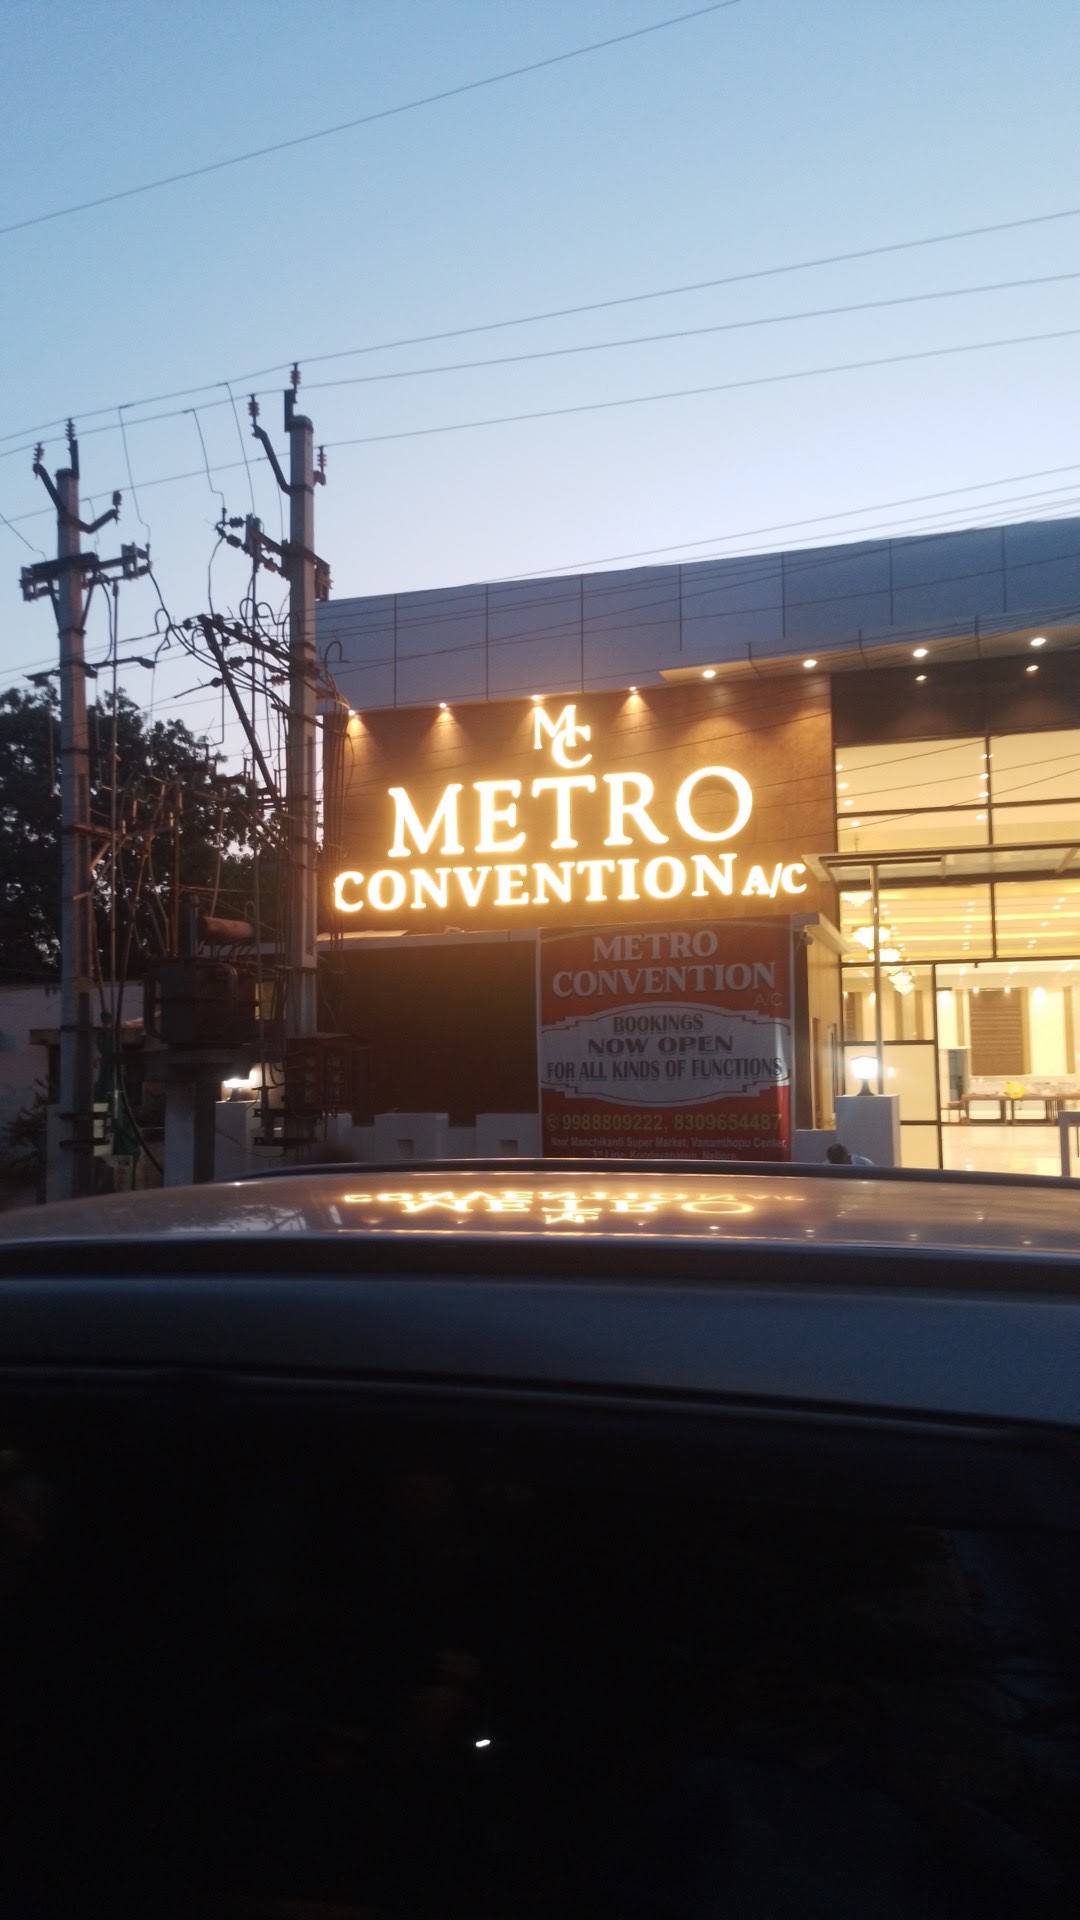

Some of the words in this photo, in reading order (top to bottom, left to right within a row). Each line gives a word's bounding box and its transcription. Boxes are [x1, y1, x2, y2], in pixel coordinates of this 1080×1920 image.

[387, 765, 753, 858] METRO
[333, 852, 738, 913] CONVENTION
[741, 862, 807, 898] A/C
[592, 930, 718, 963] METRO
[552, 961, 776, 998] CONVENTION
[613, 1013, 704, 1034] BOOKINGS
[588, 1037, 648, 1056] NOW
[658, 1035, 733, 1055] OPEN
[547, 1062, 575, 1081] FOR
[579, 1061, 608, 1079] ALL
[613, 1059, 660, 1080] KINDS
[665, 1059, 687, 1078] OF
[691, 1057, 783, 1079] FUNCTIONS
[673, 1113, 782, 1131] 8309654487
